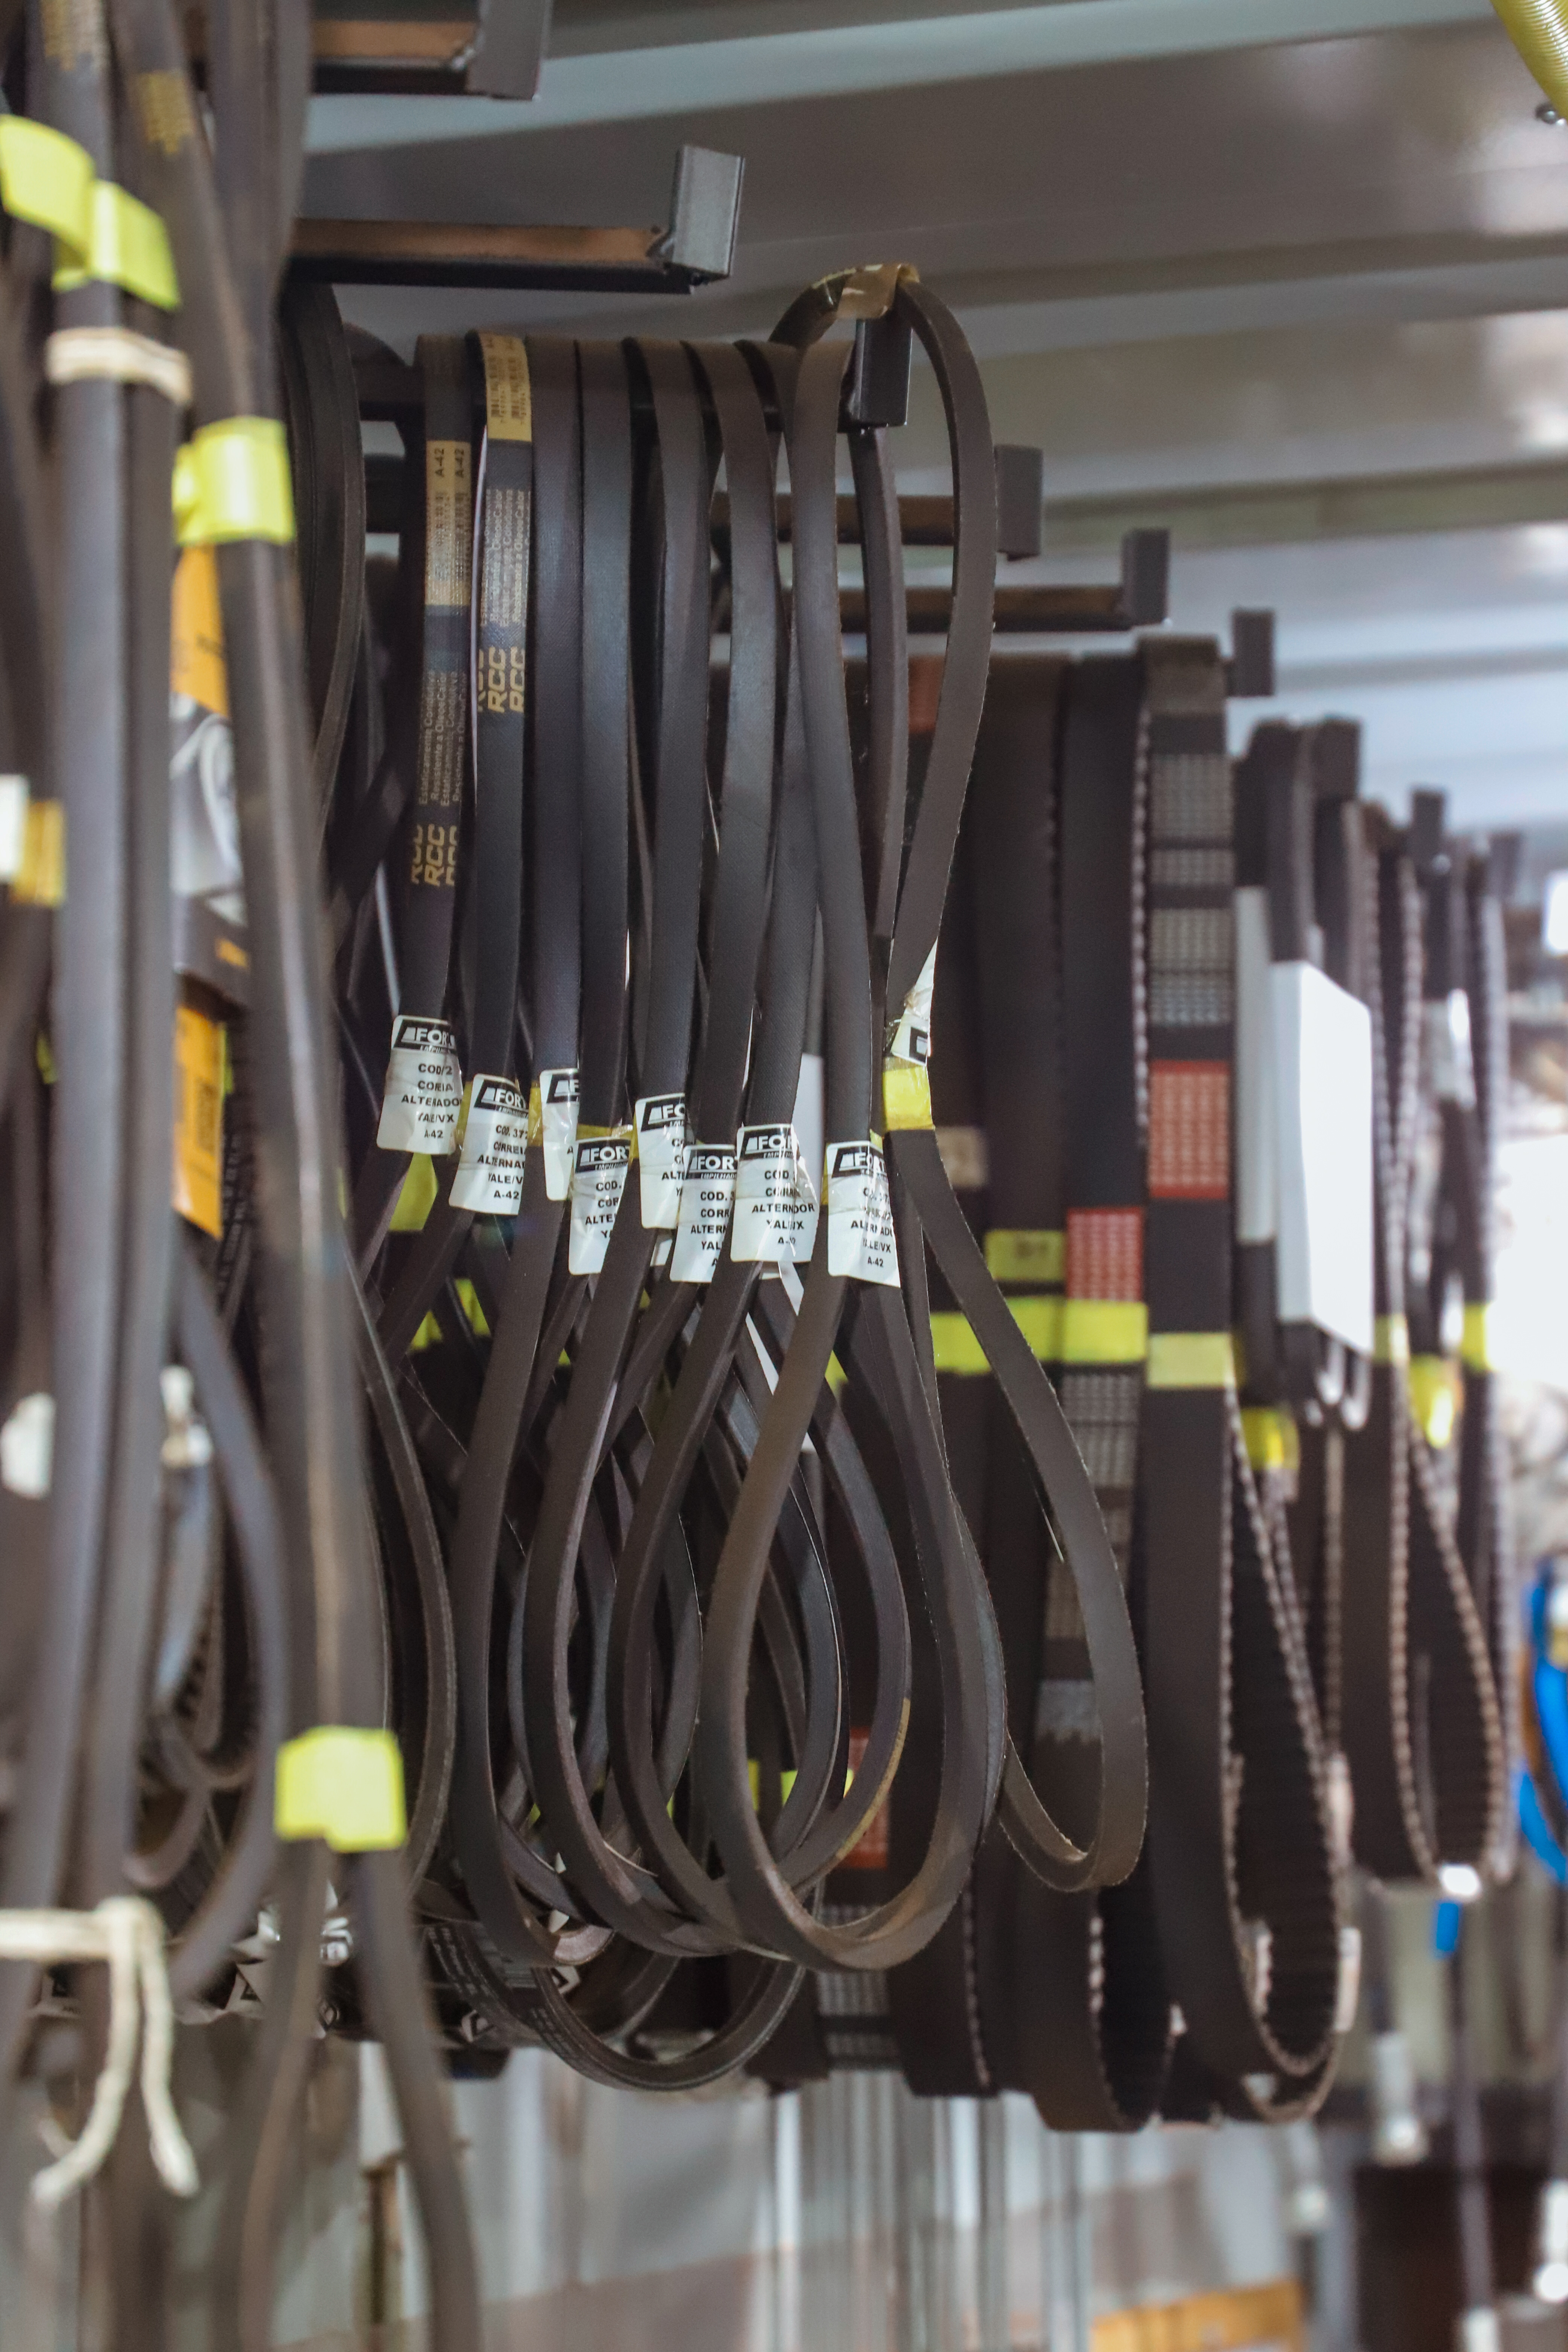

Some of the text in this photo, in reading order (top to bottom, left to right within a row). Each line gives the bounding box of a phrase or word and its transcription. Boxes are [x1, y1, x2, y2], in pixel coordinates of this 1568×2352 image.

[435, 448, 444, 477] A-42
[455, 448, 464, 478] A-42
[487, 646, 508, 713] RCC
[424, 823, 445, 887] RCC
[493, 1141, 525, 1155] CORREI
[596, 1180, 622, 1191] COD.
[493, 1190, 520, 1200] A-42
[700, 1190, 727, 1201] COD.
[585, 1213, 617, 1225] ALTE
[868, 1255, 884, 1268] A-42
